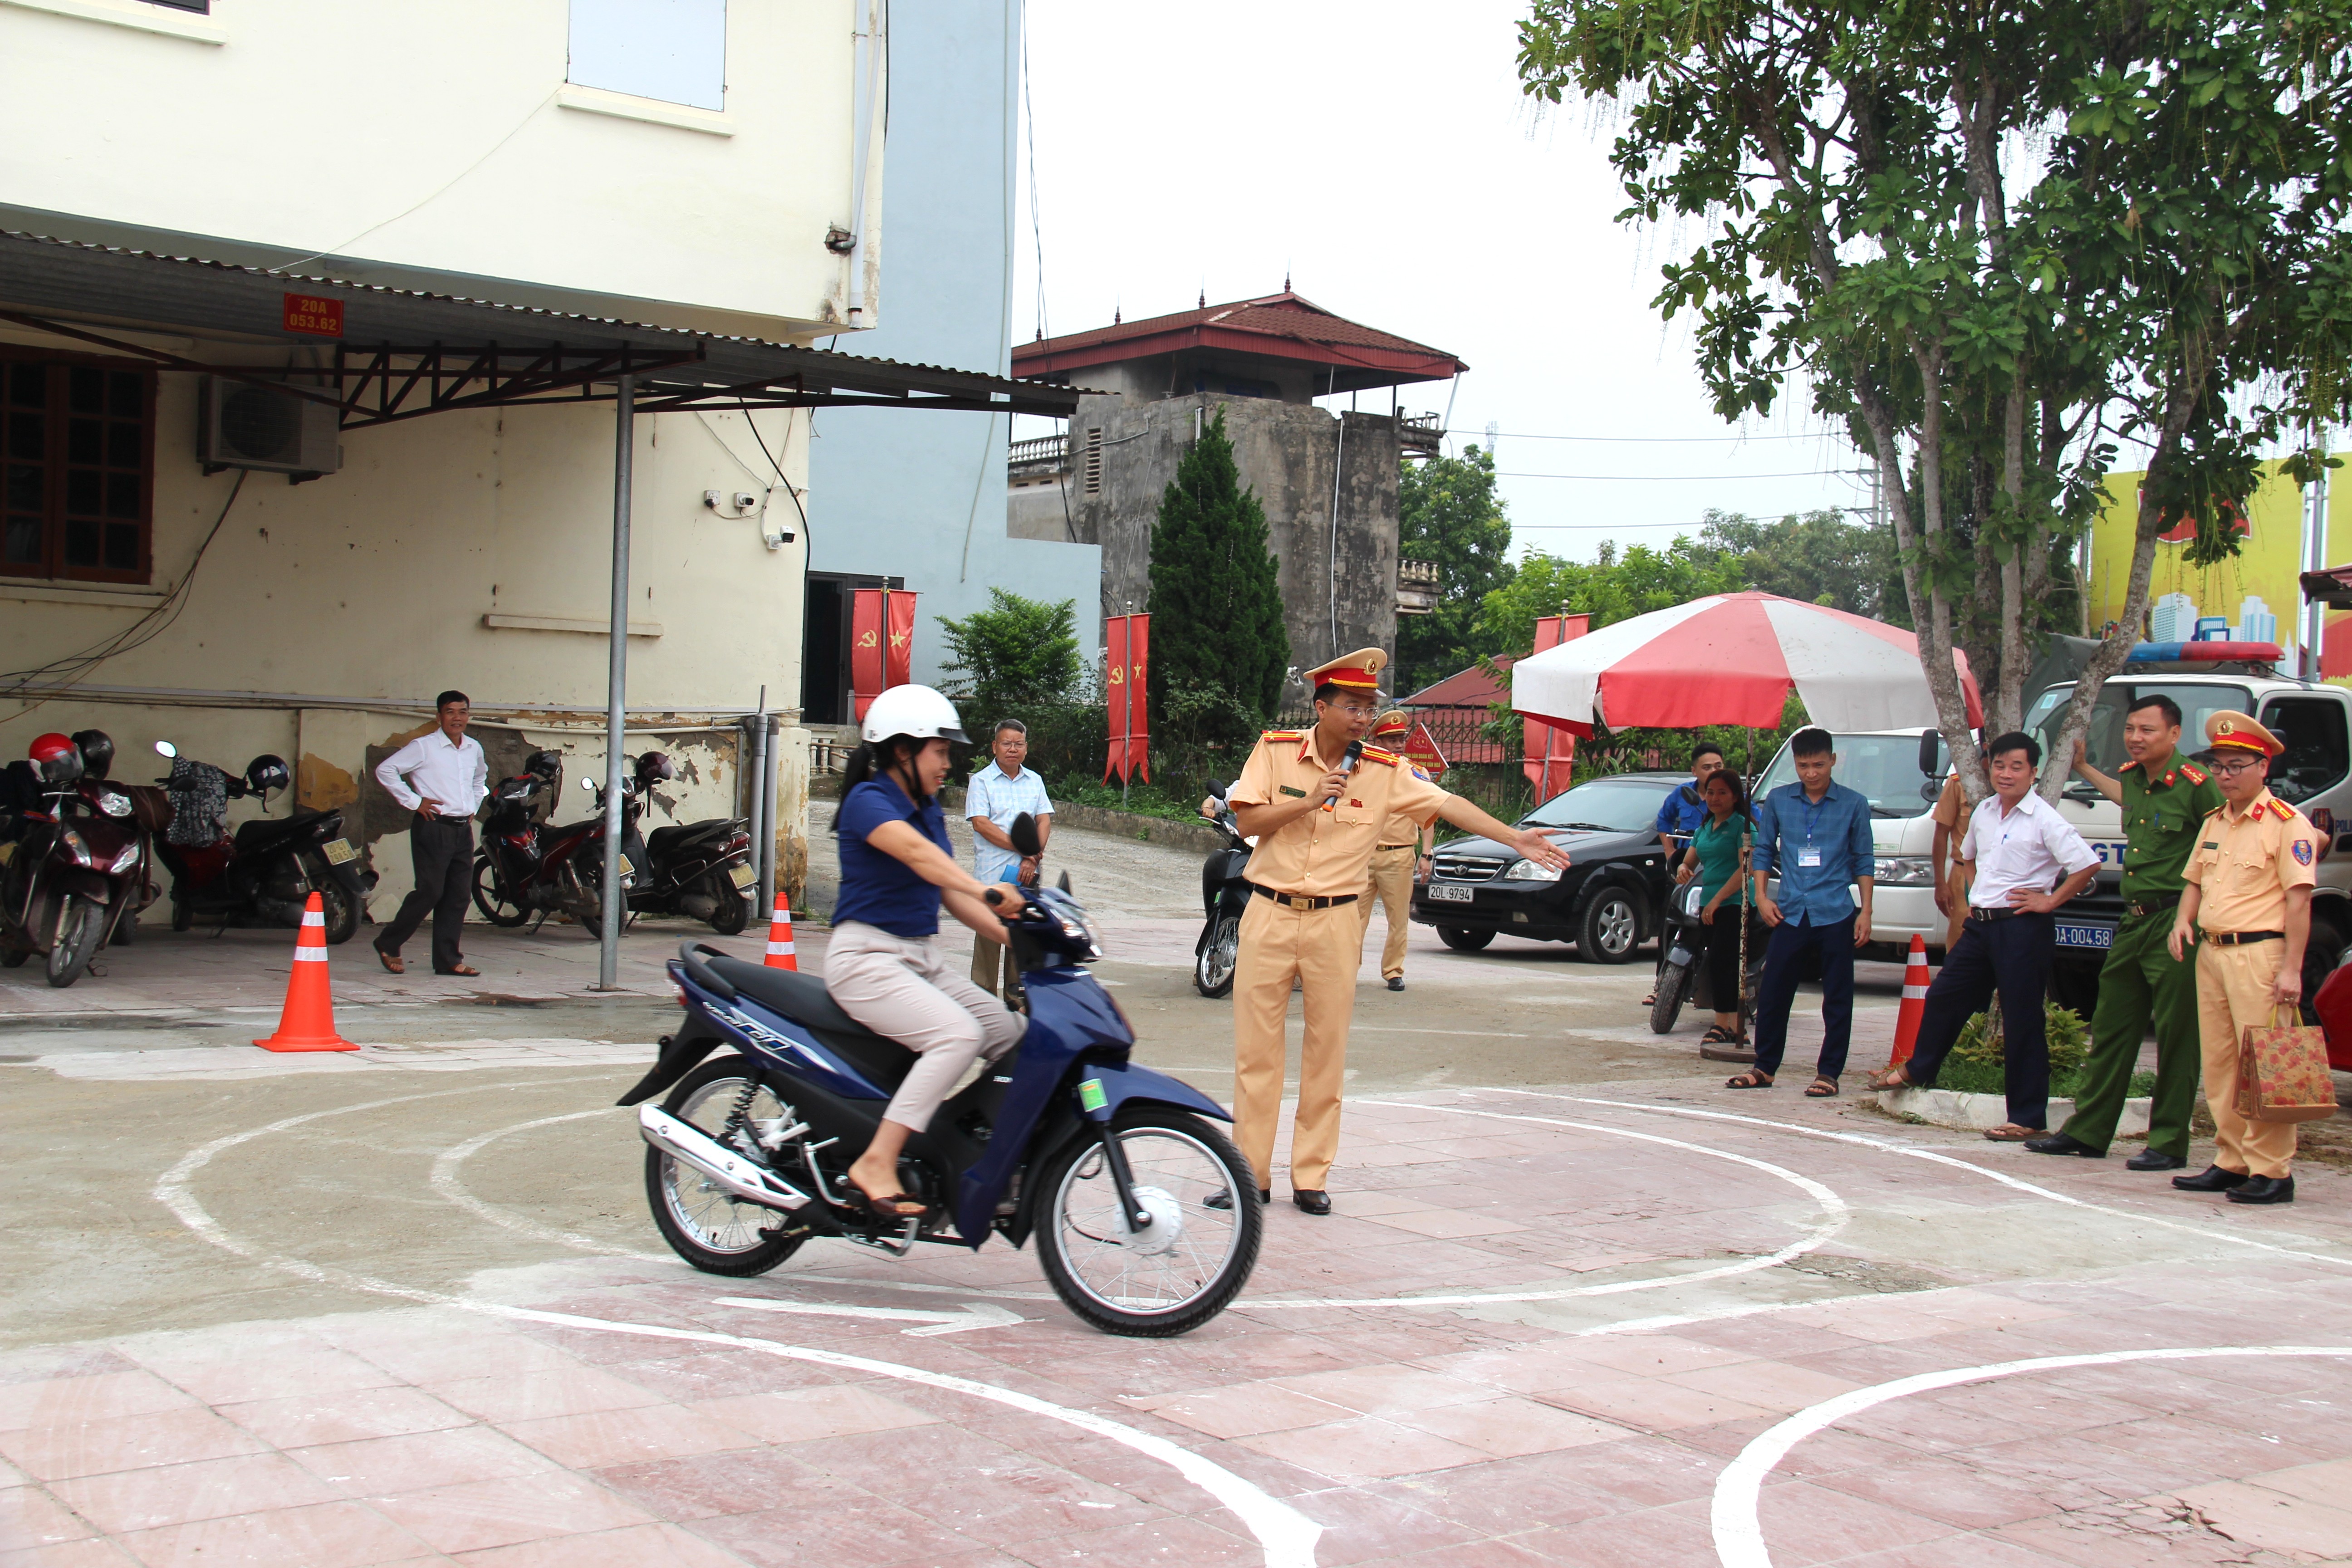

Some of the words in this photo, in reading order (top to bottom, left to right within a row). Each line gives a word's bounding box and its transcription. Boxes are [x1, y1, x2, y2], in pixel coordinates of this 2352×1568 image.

[301, 299, 327, 314] 20A
[289, 313, 337, 331] 053.62
[2091, 843, 2127, 864] GT
